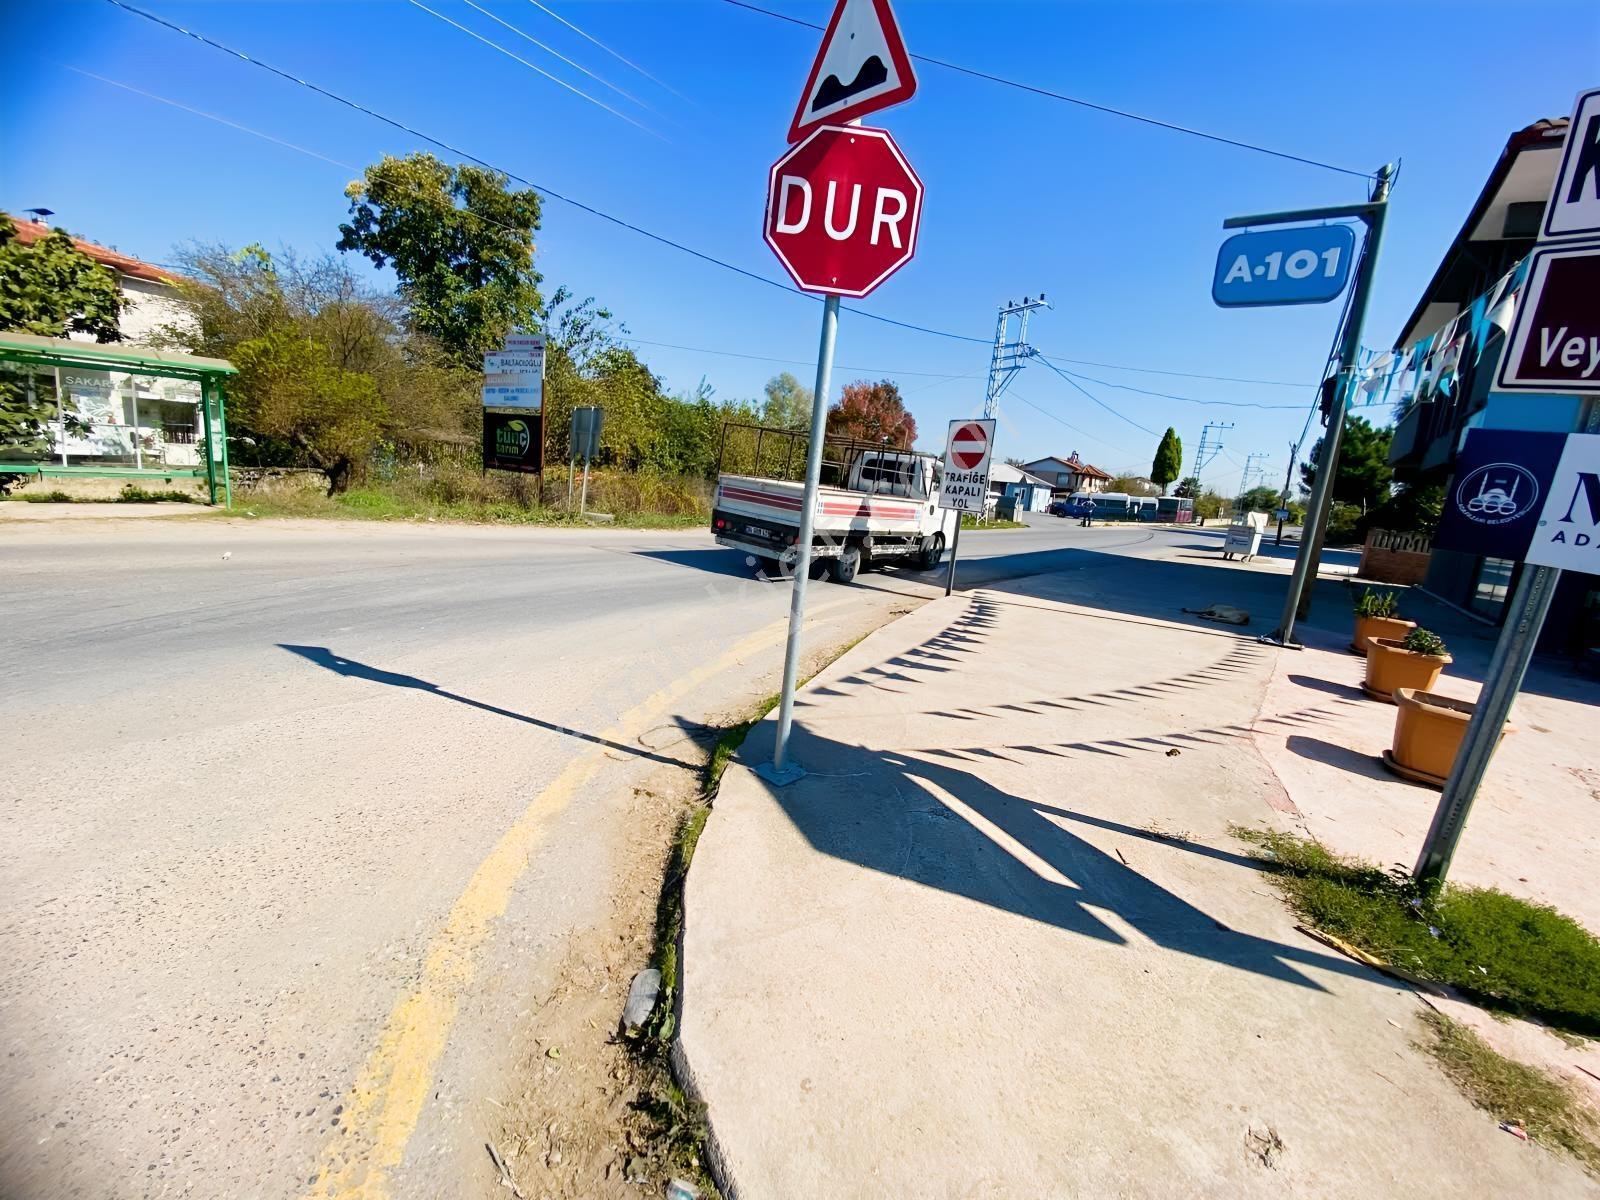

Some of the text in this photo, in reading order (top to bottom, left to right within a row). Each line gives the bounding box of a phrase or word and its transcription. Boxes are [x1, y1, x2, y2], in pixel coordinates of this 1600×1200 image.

[776, 175, 907, 249] DUR
[1540, 326, 1600, 378] Vey
[945, 471, 986, 485] TRAFİĞE
[945, 485, 981, 497] KAPALI
[952, 497, 969, 509] YOL
[1551, 530, 1600, 549] AD
